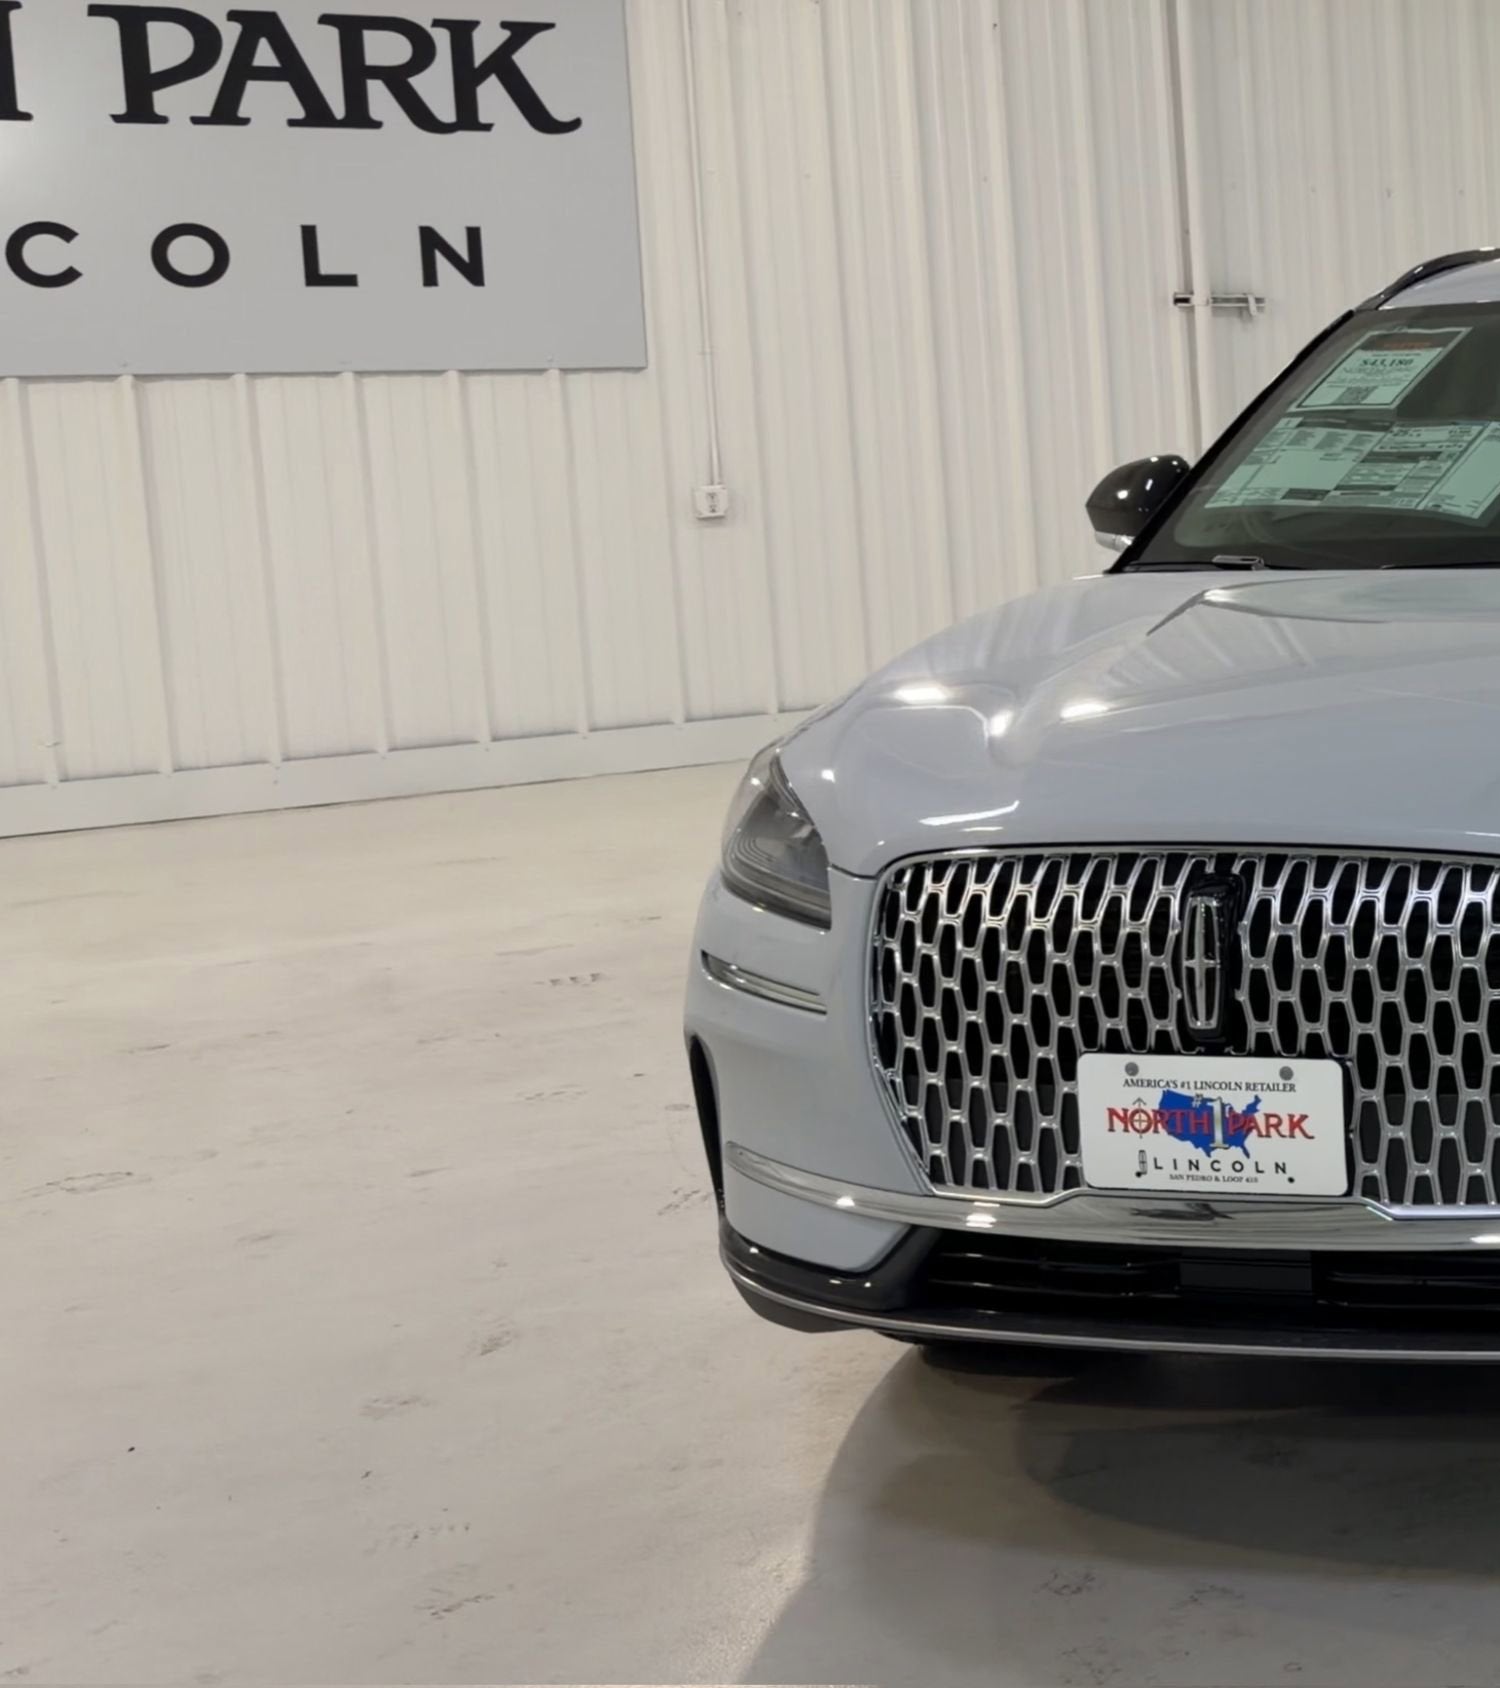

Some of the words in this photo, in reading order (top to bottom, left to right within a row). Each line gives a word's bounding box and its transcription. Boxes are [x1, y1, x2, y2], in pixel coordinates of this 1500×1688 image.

[87, 4, 582, 135] PARK
[1123, 1078, 1178, 1090] AMERICA'S
[1180, 1080, 1191, 1090] #1
[1194, 1081, 1243, 1092] LINCOLN
[1245, 1082, 1296, 1093] RETAILER
[1107, 1107, 1211, 1135] NORTH
[1228, 1110, 1315, 1140] PARK
[1153, 1157, 1287, 1175] LINCOLN
[1169, 1173, 1185, 1181] SAN
